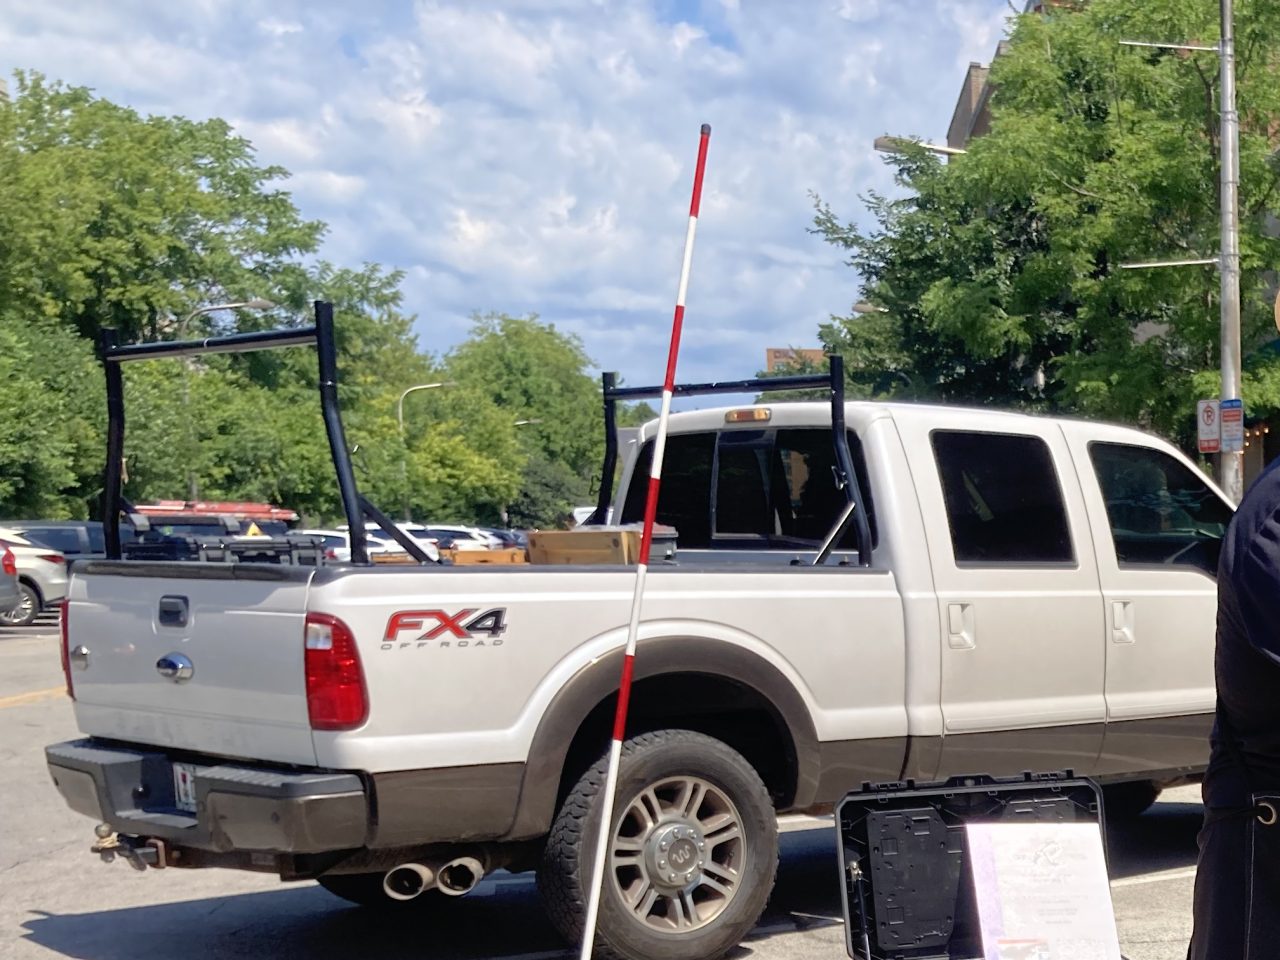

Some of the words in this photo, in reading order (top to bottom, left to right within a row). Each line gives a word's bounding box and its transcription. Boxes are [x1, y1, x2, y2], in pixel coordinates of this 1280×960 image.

[382, 607, 508, 641] FX4
[380, 642, 429, 650] OFF
[440, 639, 504, 648] ROAD
